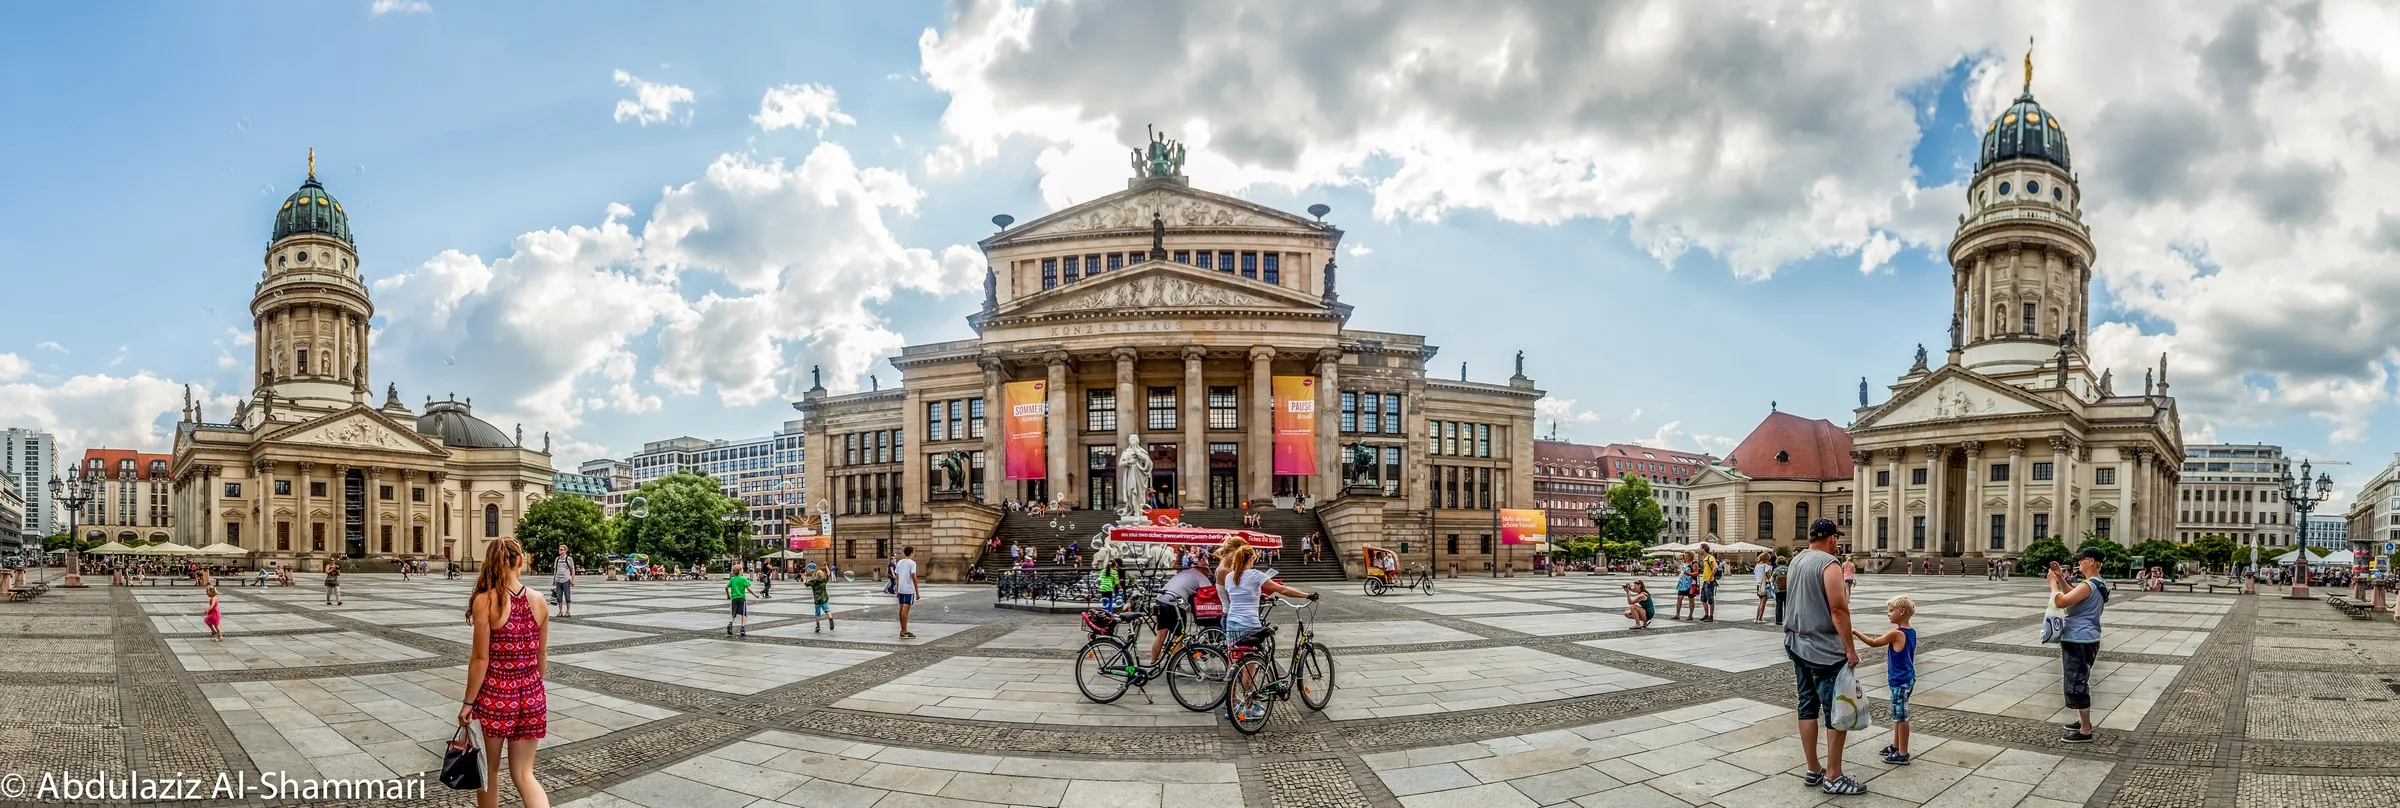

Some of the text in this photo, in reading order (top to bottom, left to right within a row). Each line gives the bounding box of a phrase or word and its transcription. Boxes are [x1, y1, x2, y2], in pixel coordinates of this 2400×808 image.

[1051, 321, 1268, 336] KONZERTHAUS BERLIN
[1015, 404, 1043, 415] SOMMER
[1291, 401, 1312, 411] PAUSE
